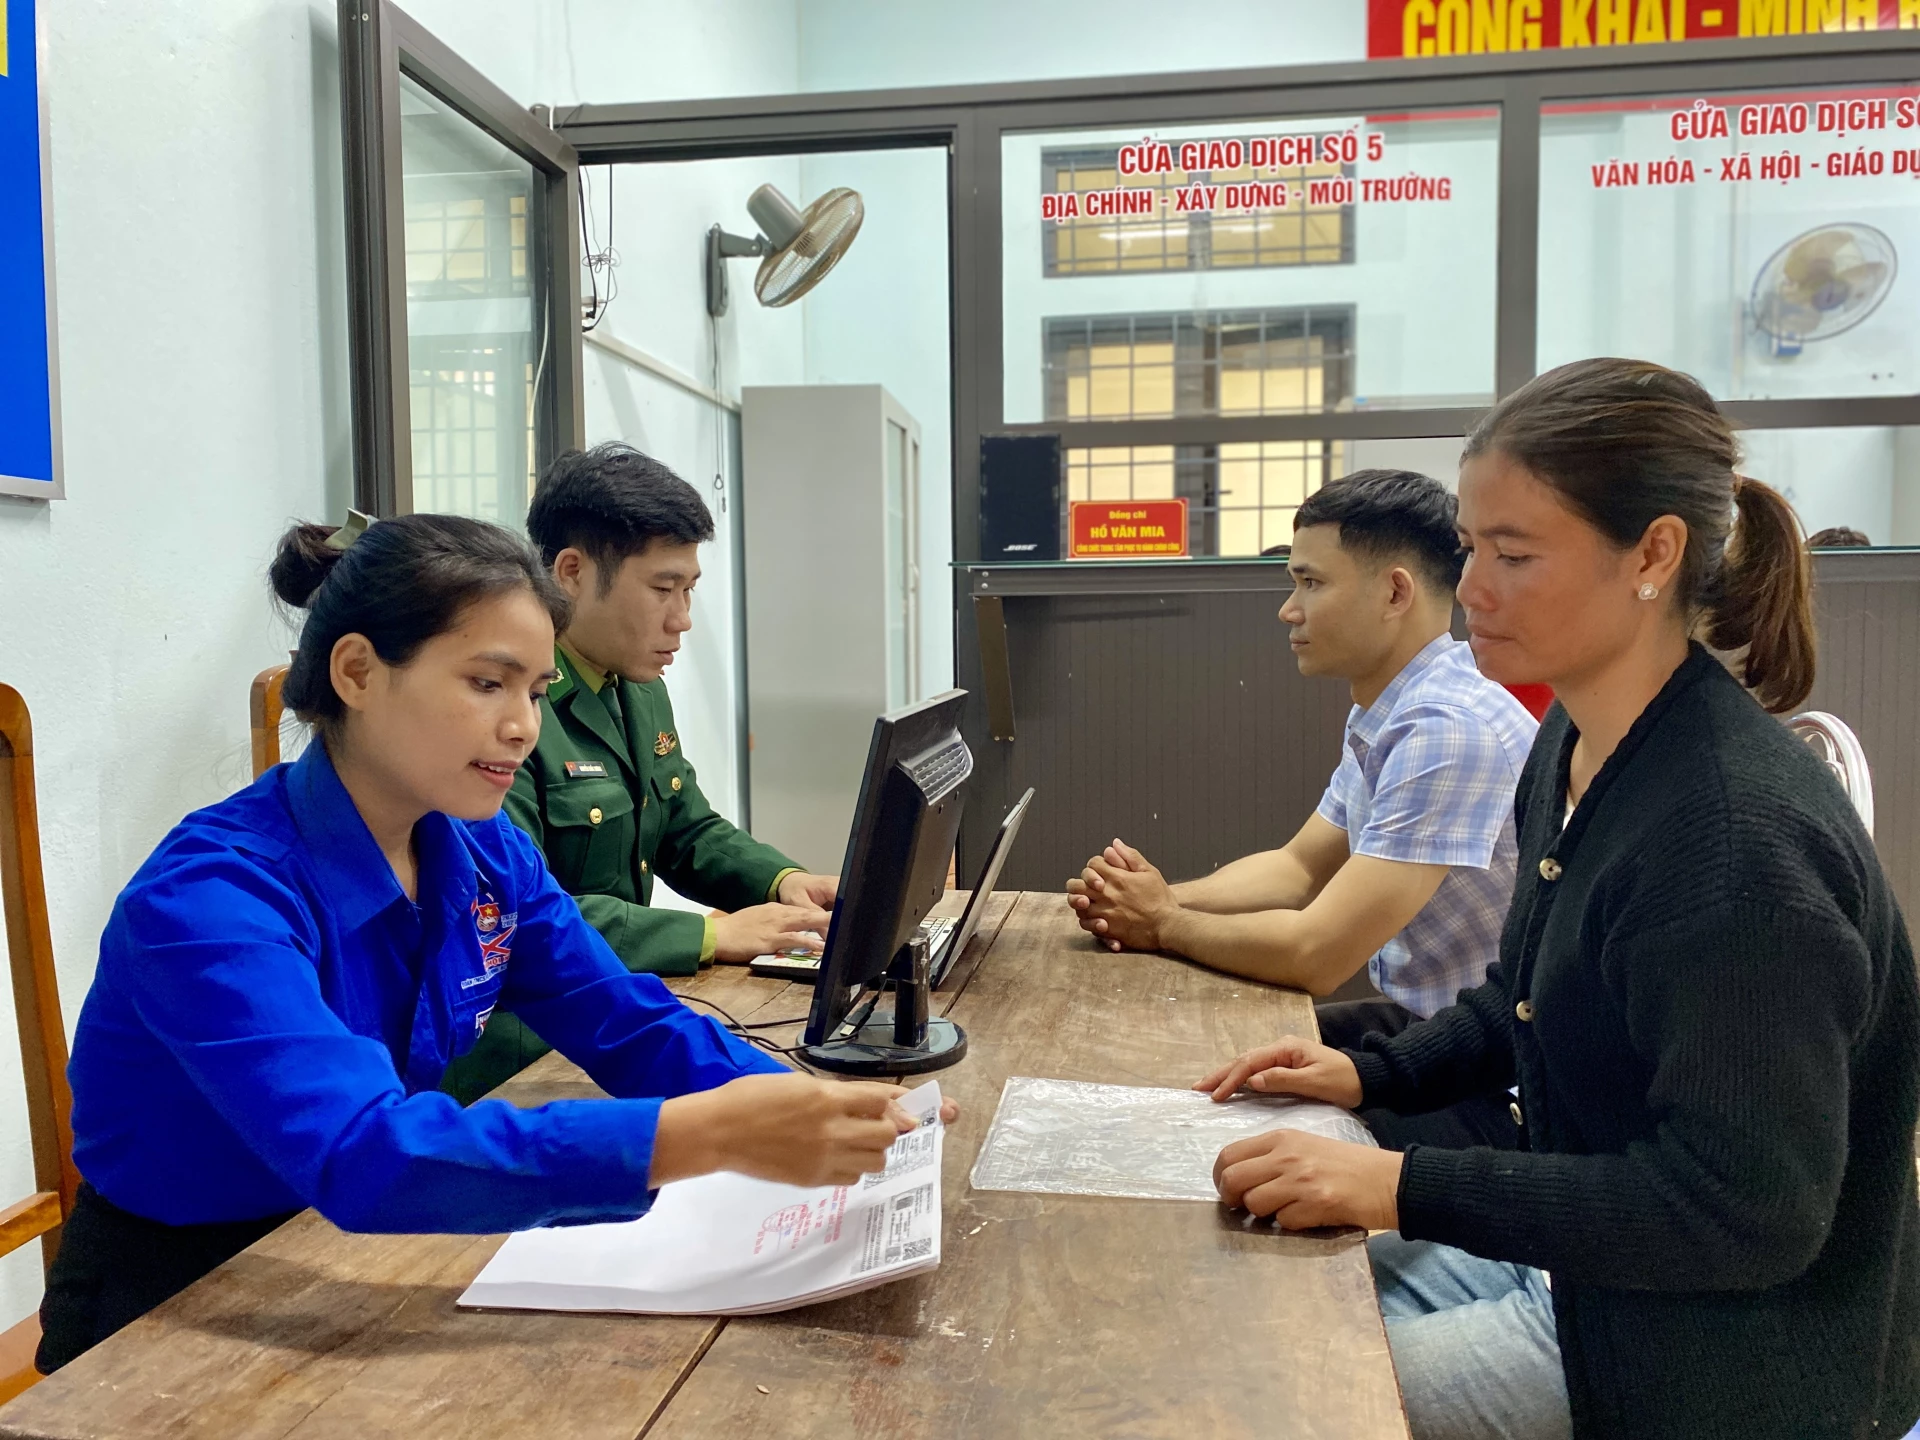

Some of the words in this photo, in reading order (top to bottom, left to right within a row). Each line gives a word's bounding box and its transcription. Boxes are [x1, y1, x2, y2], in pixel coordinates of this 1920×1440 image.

[1559, 0, 1686, 48] KHAI
[1738, 0, 1878, 38] MINH
[1671, 100, 1728, 140] CỬA
[1741, 105, 1807, 135] GIAO
[1818, 101, 1886, 138] DỊCH
[1119, 136, 1173, 175] CỬA
[1181, 140, 1242, 171] GIAO
[1251, 136, 1314, 173] DỊCH
[1322, 123, 1361, 164] SỐ
[1367, 133, 1383, 161] 5
[1591, 159, 1639, 187] VĂN
[1647, 155, 1695, 185] HÓA
[1721, 152, 1752, 180] XÃ
[1760, 149, 1800, 185] HỘI
[1827, 146, 1885, 180] GIÁO
[1042, 194, 1079, 223] ĐỊA
[1086, 186, 1153, 217] CHÍNH
[1175, 182, 1218, 212] XÂY
[1225, 181, 1287, 214] DỰNG
[1310, 175, 1353, 206] MÔI
[1361, 172, 1452, 202] TRƯỜNG
[1003, 543, 1038, 552] BOSE
[1140, 525, 1165, 538] MIA
